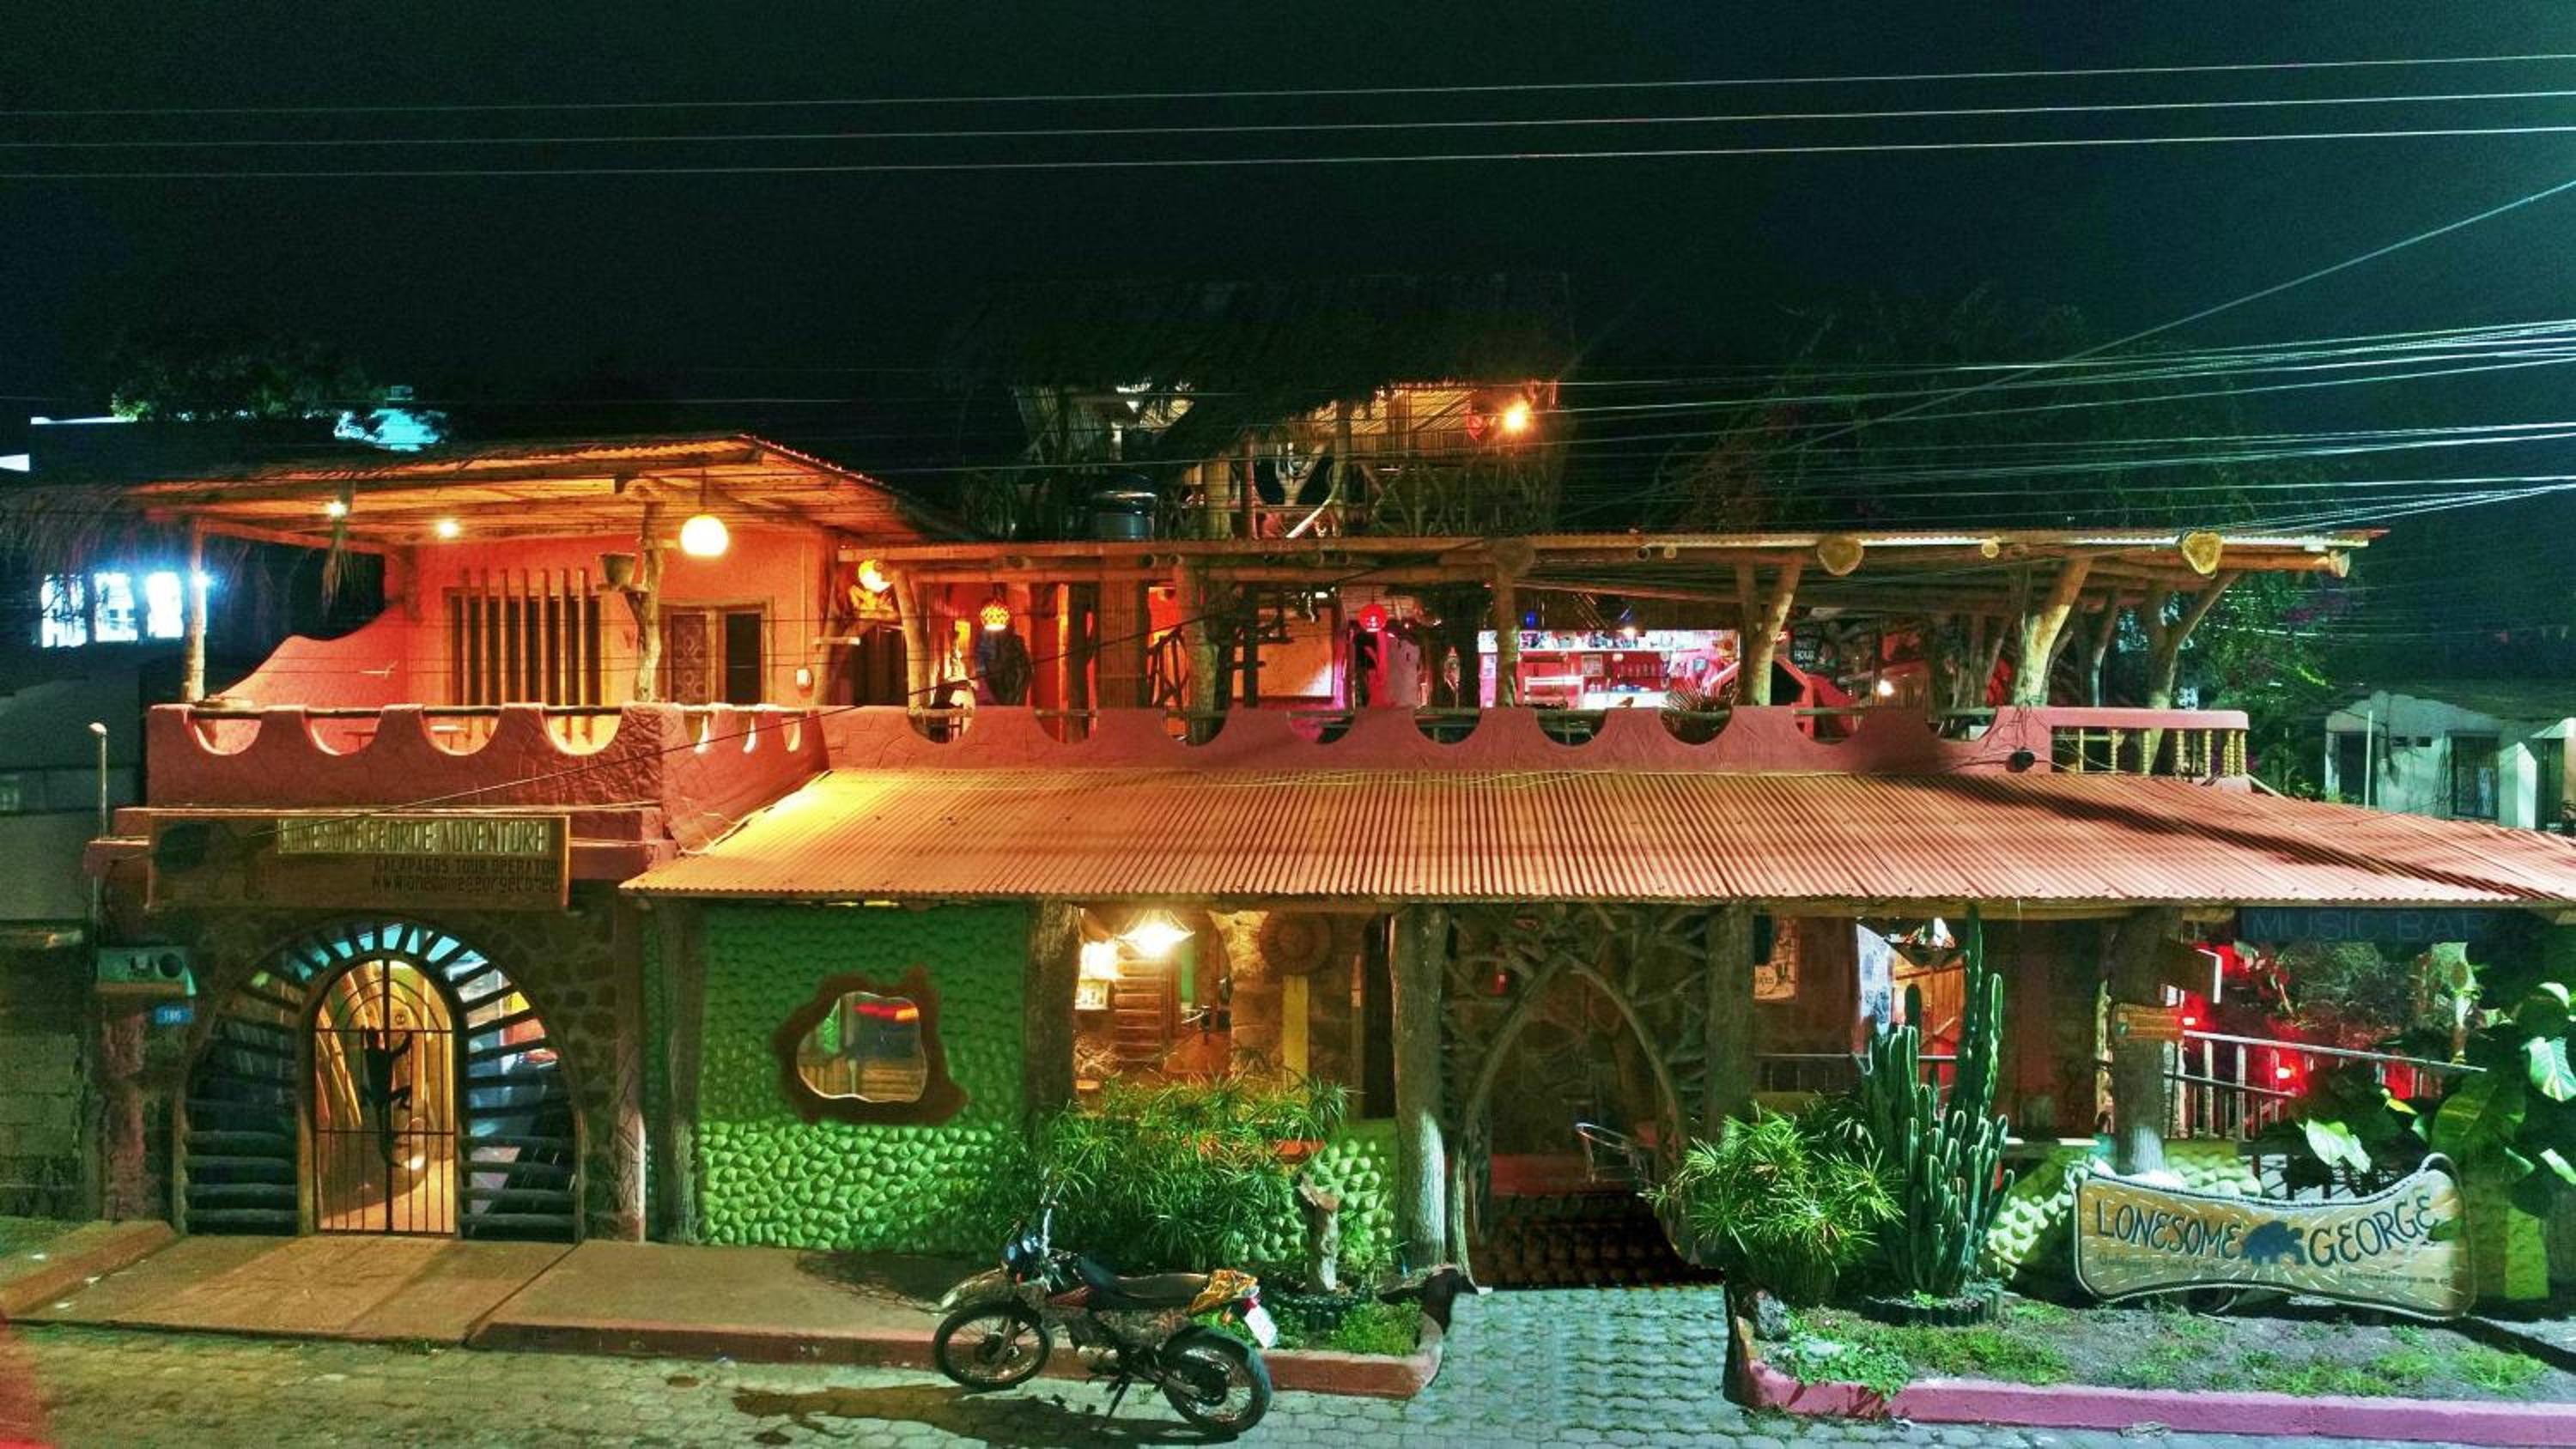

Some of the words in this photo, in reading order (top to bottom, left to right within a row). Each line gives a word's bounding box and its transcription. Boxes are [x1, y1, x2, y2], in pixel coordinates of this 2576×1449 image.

[1794, 649, 1815, 660] HOUR
[440, 822, 546, 852] ADVENTURE
[453, 858, 487, 874] TOUR
[2252, 911, 2379, 942] MUSIC
[2397, 910, 2490, 943] BAR
[2096, 1200, 2244, 1260] LONESOME
[2308, 1190, 2439, 1268] GEORGE
